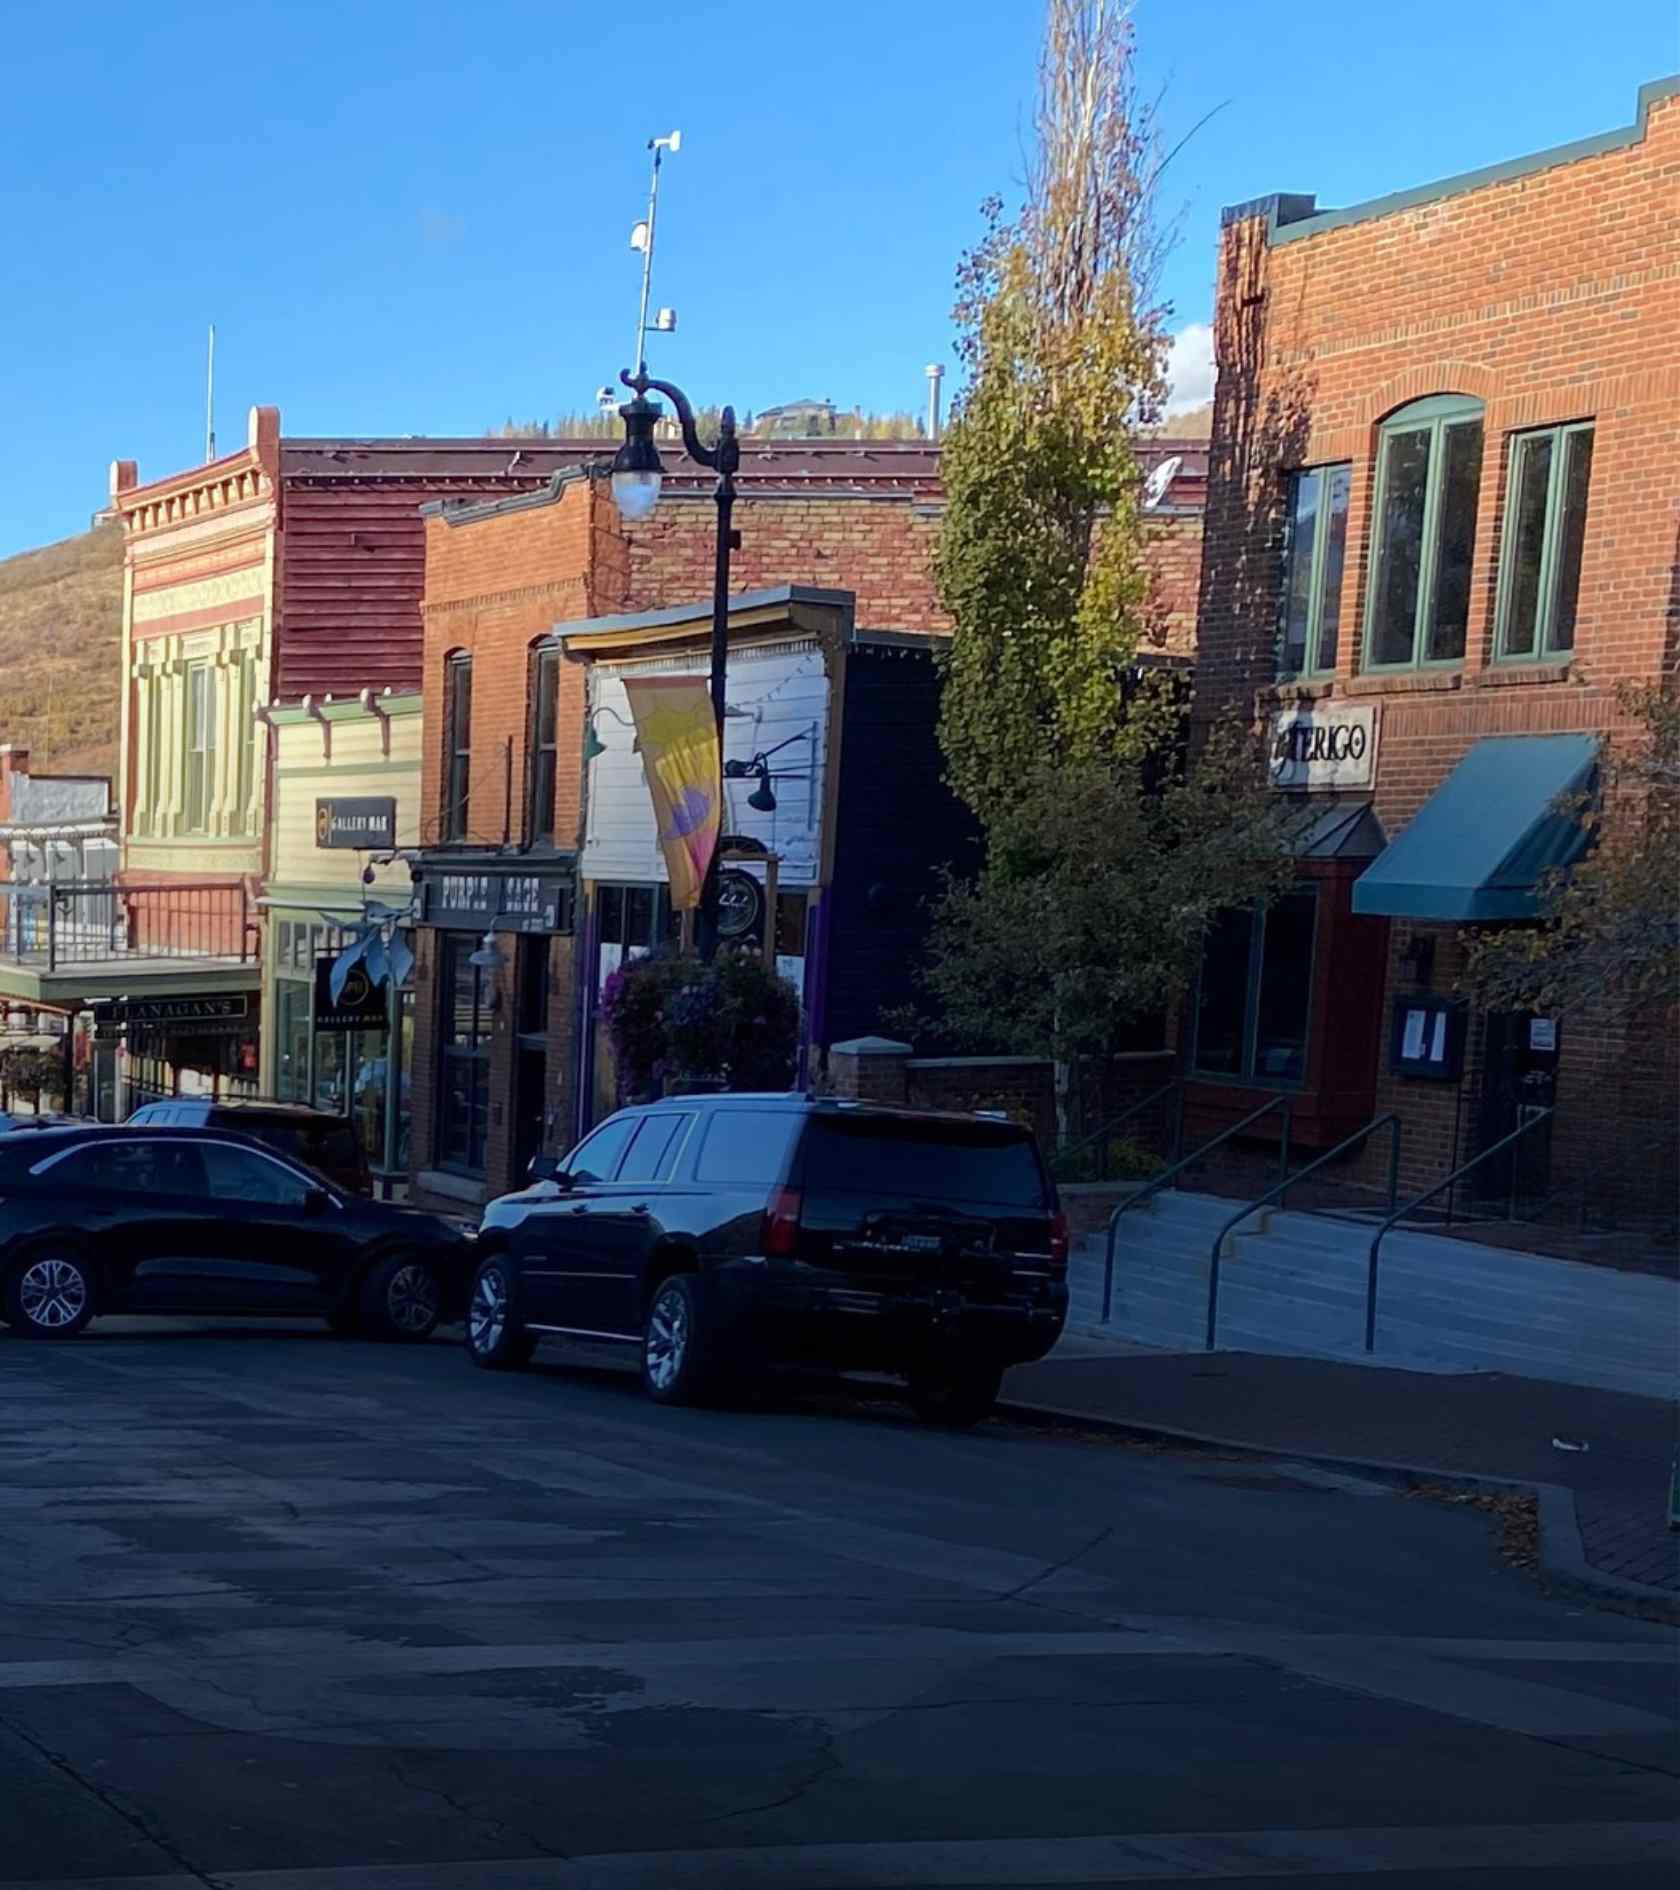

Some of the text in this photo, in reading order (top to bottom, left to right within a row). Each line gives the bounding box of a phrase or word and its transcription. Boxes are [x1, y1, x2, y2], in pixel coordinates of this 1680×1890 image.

[331, 815, 387, 831] GALLERY BAR
[441, 875, 540, 913] PURPLE SAGE
